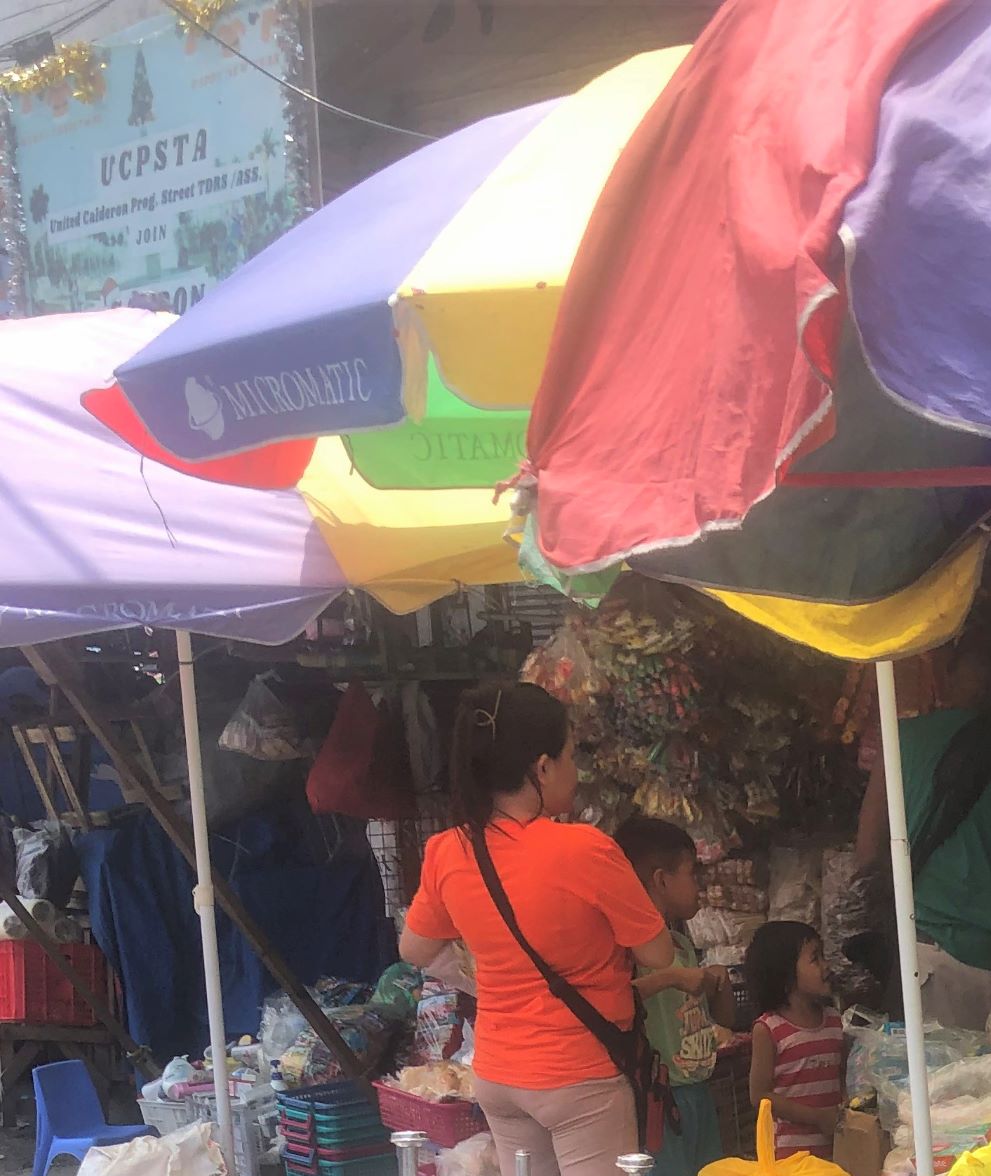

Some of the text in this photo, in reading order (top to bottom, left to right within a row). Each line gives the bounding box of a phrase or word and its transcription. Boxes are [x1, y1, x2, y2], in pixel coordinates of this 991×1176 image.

[101, 128, 208, 187] UCPSTA
[50, 212, 81, 235] United
[83, 203, 129, 226] Calderon
[161, 183, 195, 205] Street
[136, 224, 168, 246] JOIN
[220, 357, 373, 421] MICROMATIC
